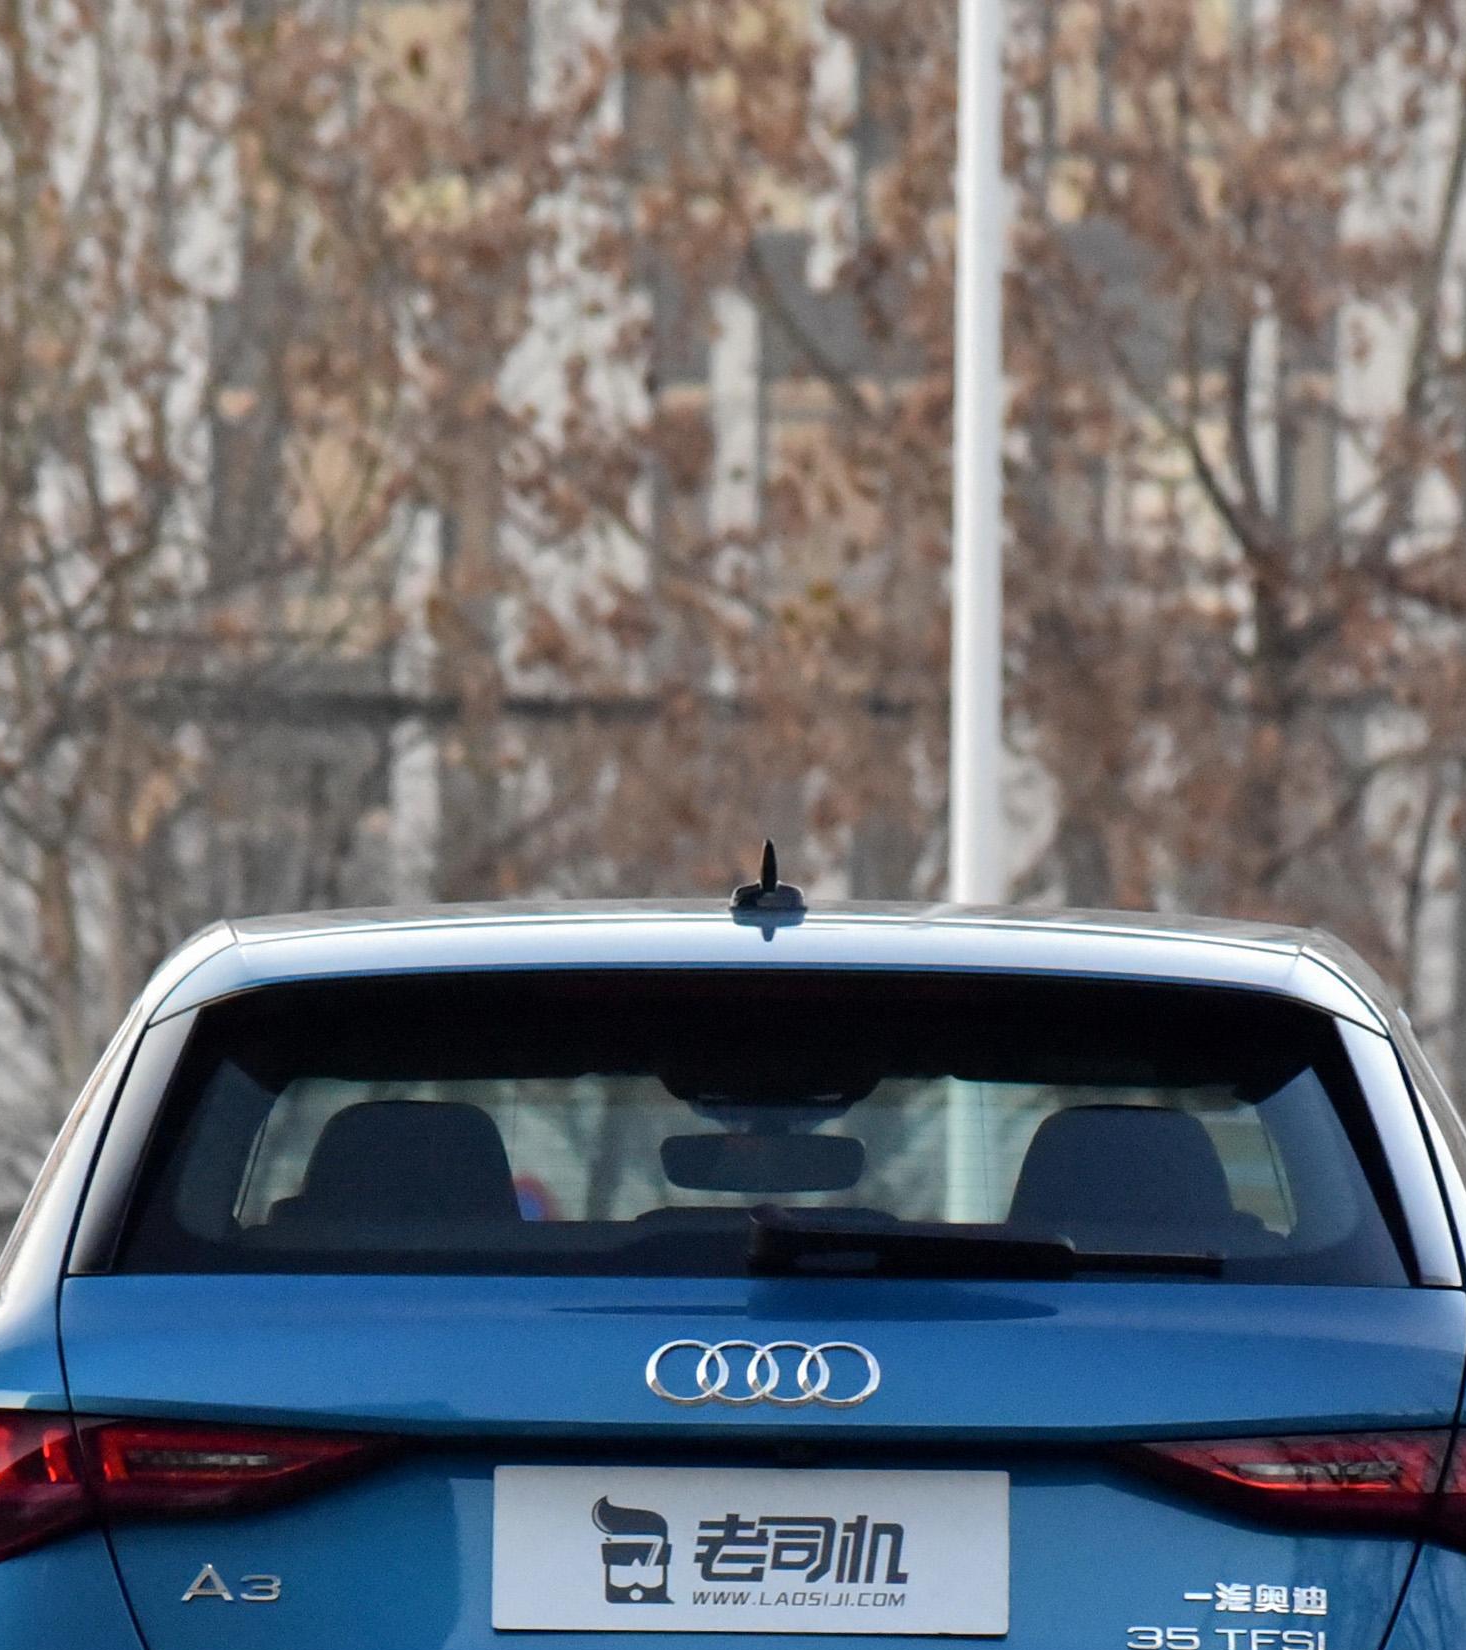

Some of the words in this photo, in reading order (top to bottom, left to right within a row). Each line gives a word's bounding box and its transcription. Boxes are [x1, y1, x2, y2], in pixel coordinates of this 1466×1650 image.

[693, 1513, 909, 1584] 老司机
[180, 1562, 282, 1601] A3
[692, 1591, 906, 1607] WWW.LAOSIJI.COM
[1184, 1582, 1328, 1615] 一汽奥迪
[1126, 1626, 1201, 1650] 35
